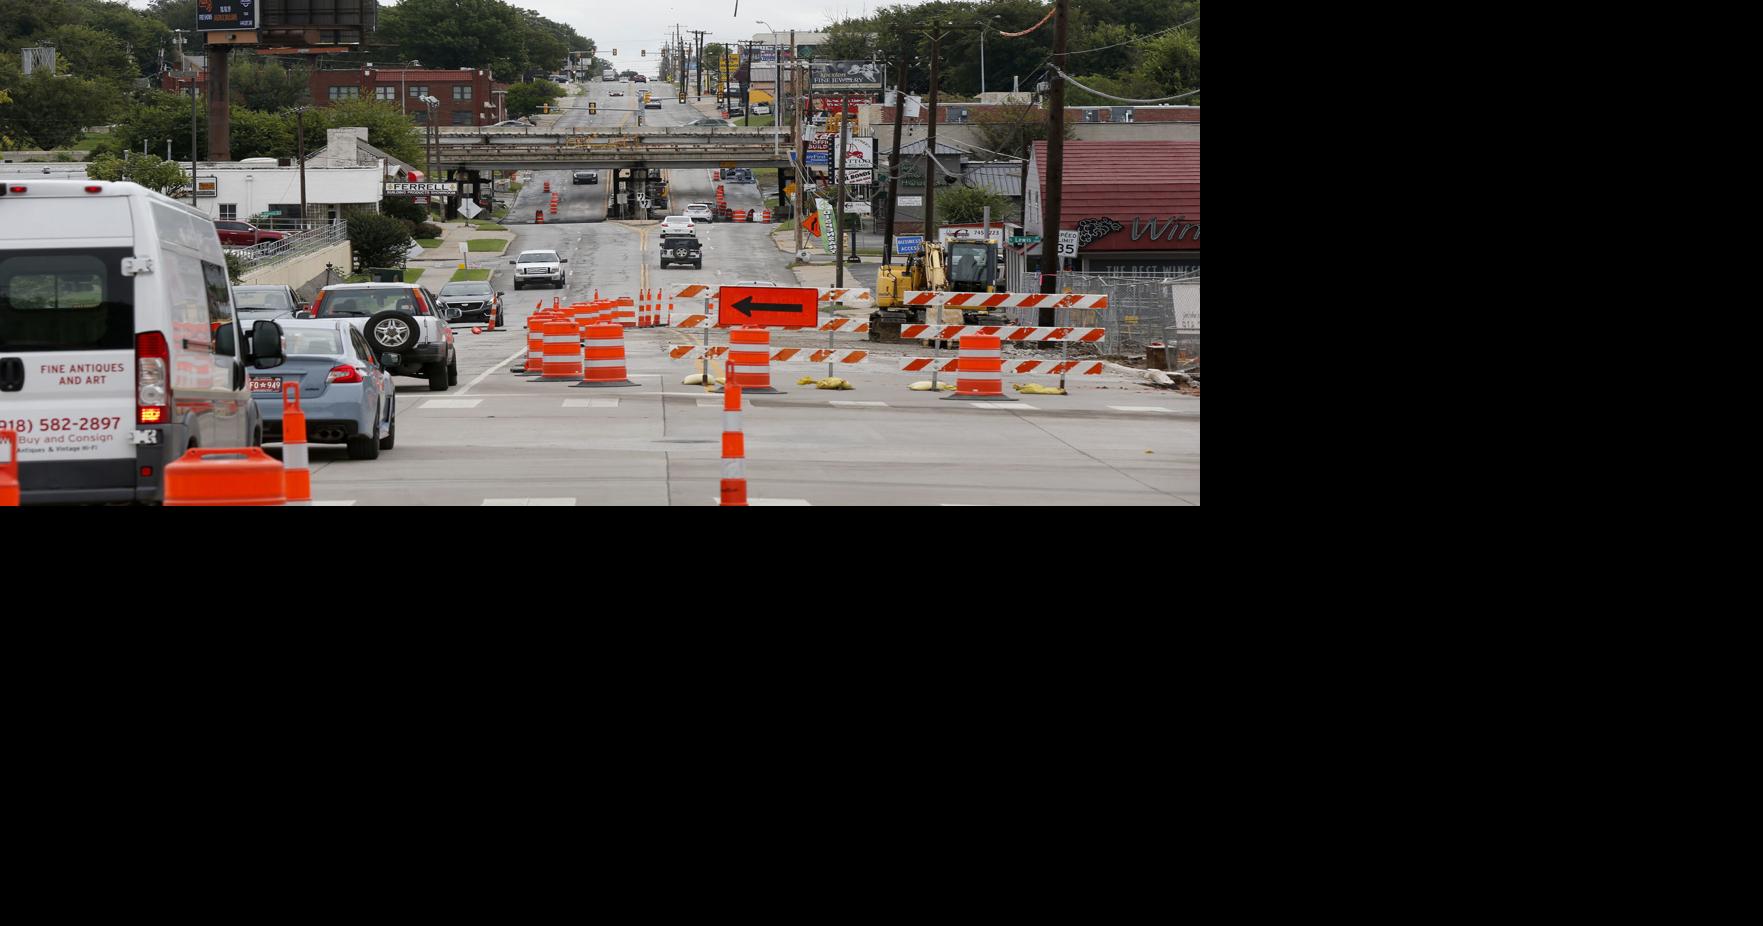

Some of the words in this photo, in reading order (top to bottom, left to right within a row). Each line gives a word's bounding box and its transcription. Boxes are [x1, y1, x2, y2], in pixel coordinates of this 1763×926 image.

[1057, 244, 1074, 254] 35
[40, 364, 66, 374] FINE
[69, 363, 125, 373] ANTIQUES
[59, 376, 82, 385] AND
[85, 375, 107, 384] ART
[40, 417, 121, 432] 582-2897
[18, 436, 40, 445] Buy
[44, 434, 65, 443] and
[68, 433, 113, 443] Consign
